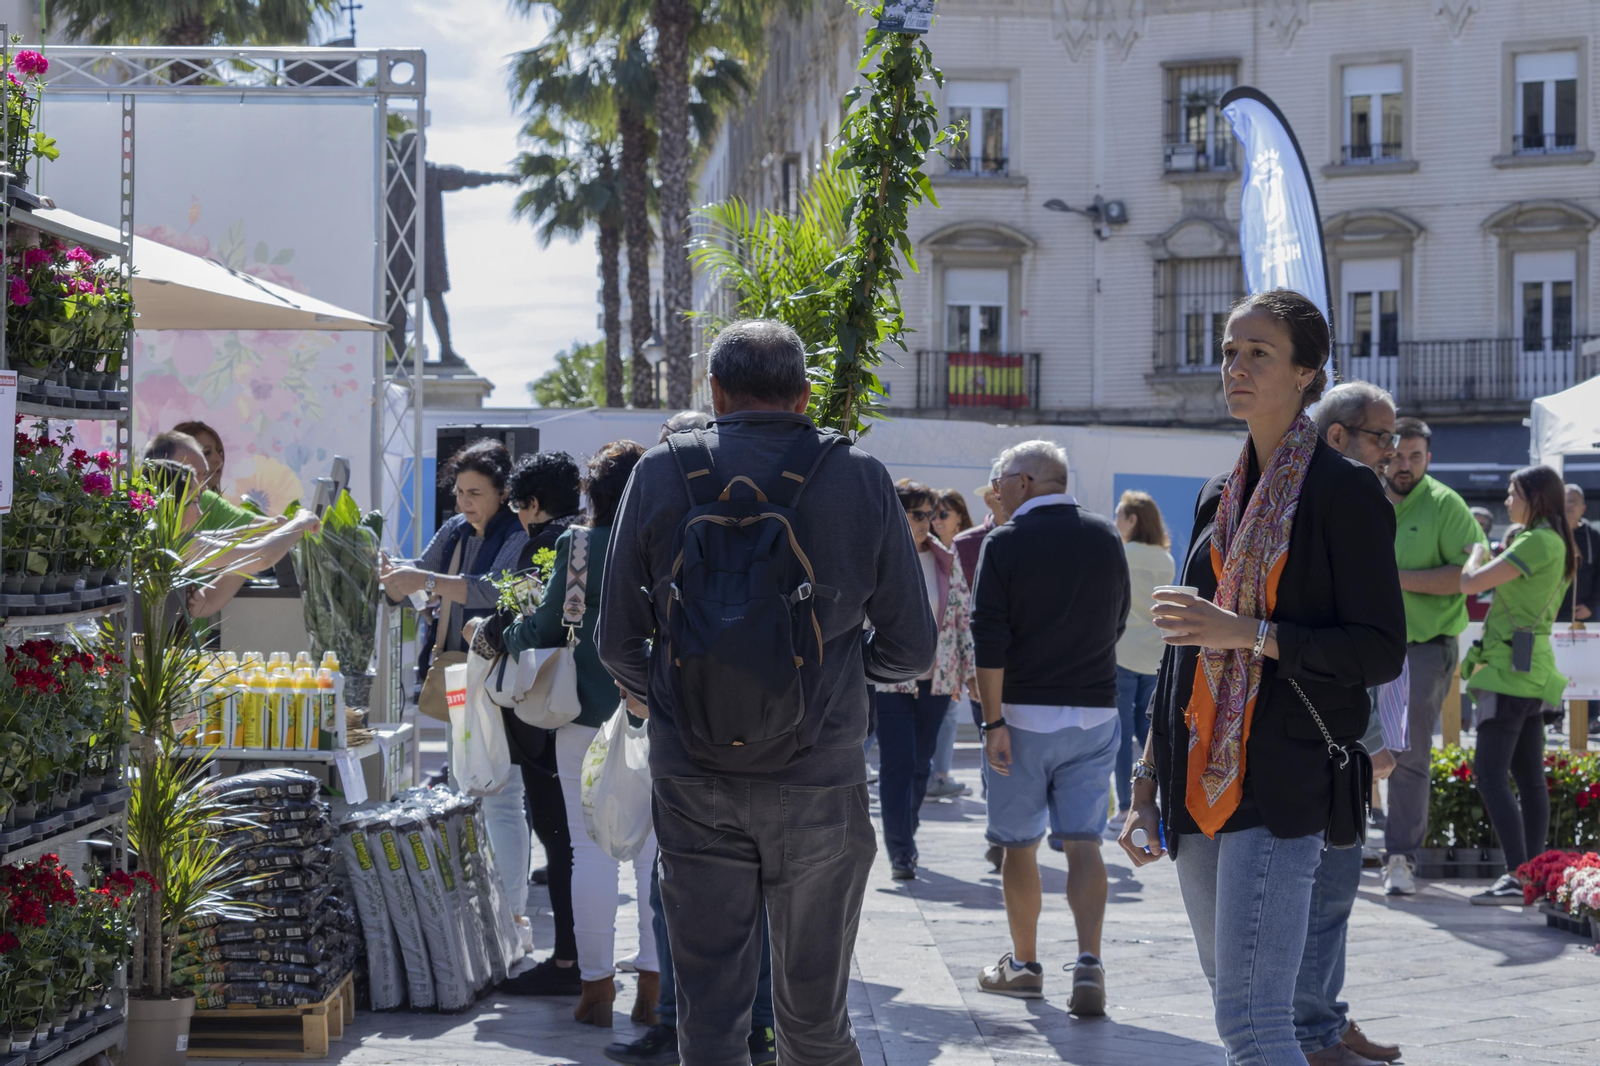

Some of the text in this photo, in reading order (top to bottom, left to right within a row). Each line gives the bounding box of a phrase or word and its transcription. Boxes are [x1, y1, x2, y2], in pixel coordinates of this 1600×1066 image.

[355, 842, 372, 869] COMPO
[384, 842, 400, 870] COMPO
[413, 842, 429, 870] COMPO
[371, 874, 386, 912] ORGANIC
[400, 874, 415, 913] ORGANIC
[429, 875, 444, 913] ORGANIC
